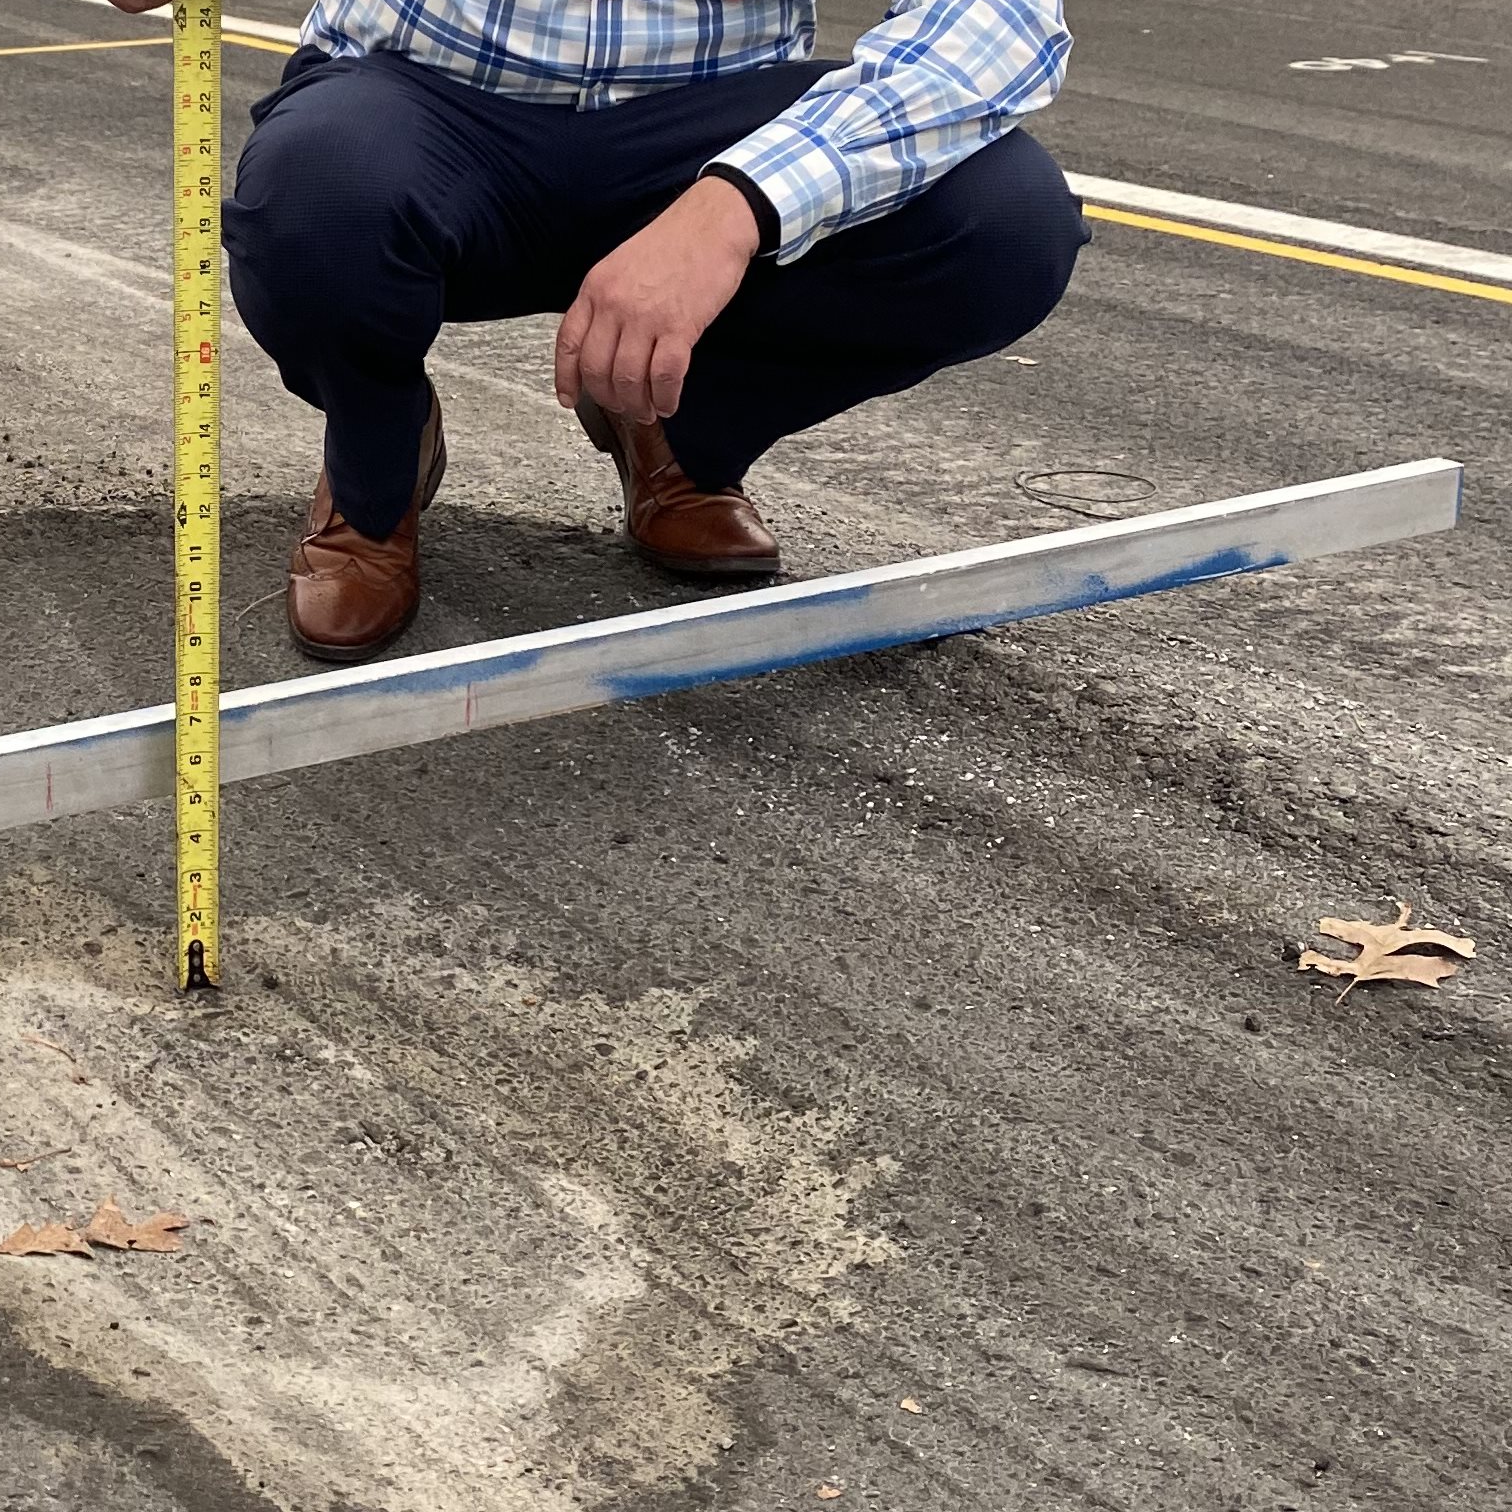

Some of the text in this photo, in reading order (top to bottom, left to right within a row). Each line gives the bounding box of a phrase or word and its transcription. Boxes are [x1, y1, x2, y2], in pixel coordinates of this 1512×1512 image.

[200, 7, 211, 28] 24
[200, 50, 211, 70] 23
[182, 94, 191, 109] 10
[200, 92, 211, 113] 22
[182, 146, 191, 155] 9
[200, 138, 211, 155] 21
[200, 176, 211, 197] 20
[200, 218, 211, 234] 19
[200, 259, 211, 275] 18
[200, 300, 211, 316] 17
[200, 346, 210, 359] 16
[199, 382, 210, 399] 15
[199, 423, 210, 439] 14
[199, 463, 210, 479] 13
[199, 504, 210, 520] 12
[189, 546, 202, 562] 11
[189, 581, 202, 602] 10
[189, 636, 201, 647] 9
[189, 676, 201, 687] 8
[189, 715, 202, 727] 7
[189, 754, 201, 765] 6
[190, 793, 202, 804] 5
[189, 833, 202, 844] 4
[190, 872, 202, 883] 3
[190, 911, 202, 922] 2
